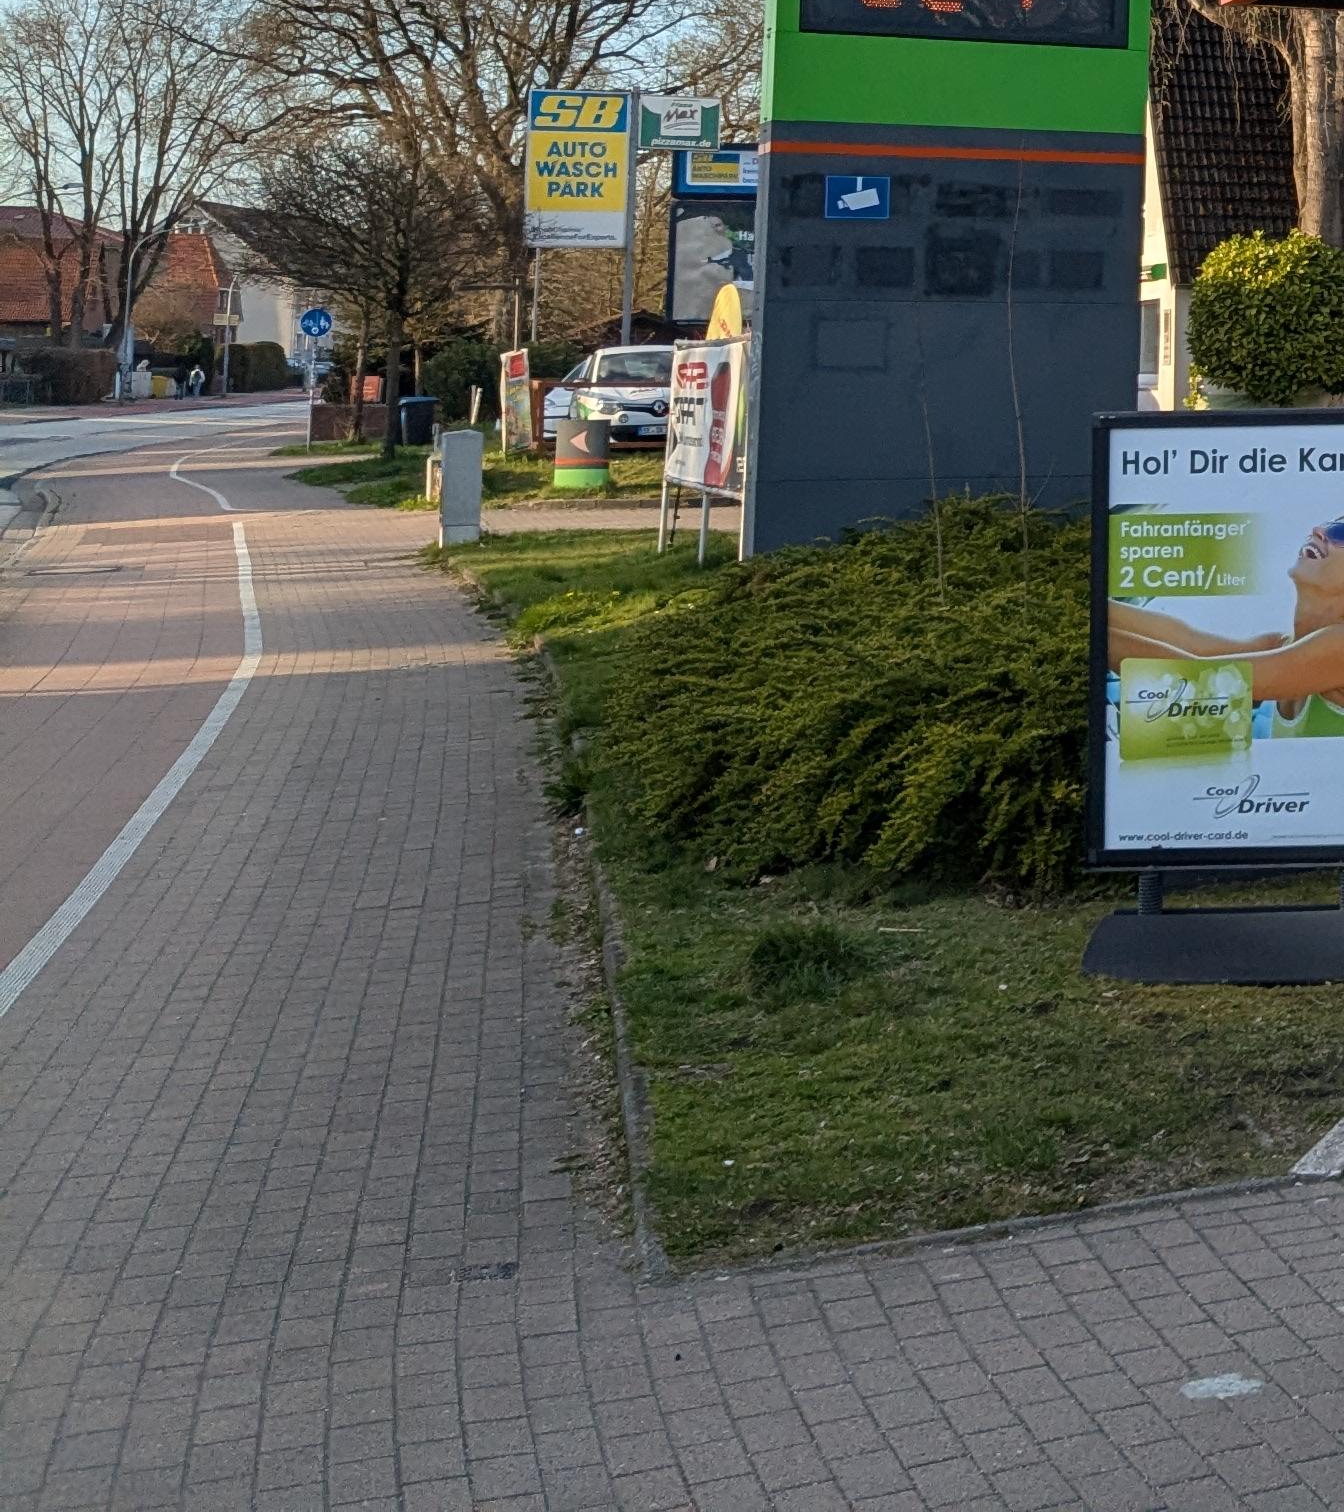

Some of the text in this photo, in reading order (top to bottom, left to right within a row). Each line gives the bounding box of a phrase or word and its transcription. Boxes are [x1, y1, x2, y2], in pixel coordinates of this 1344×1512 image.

[534, 95, 625, 128] SB
[547, 141, 608, 158] AUTO
[651, 138, 712, 148] pizzamax.de
[535, 161, 618, 178] WASCH
[547, 181, 605, 199] PARK
[1190, 449, 1228, 475] Dir
[1239, 447, 1287, 473] die
[1120, 545, 1184, 563] sparen
[1120, 566, 1135, 588] 2
[1138, 688, 1169, 701] Cool
[1167, 701, 1229, 718] Driver
[1206, 785, 1239, 797] Cool
[1237, 798, 1310, 815] Driver
[1118, 829, 1249, 843] www.cool-driver-card.de
